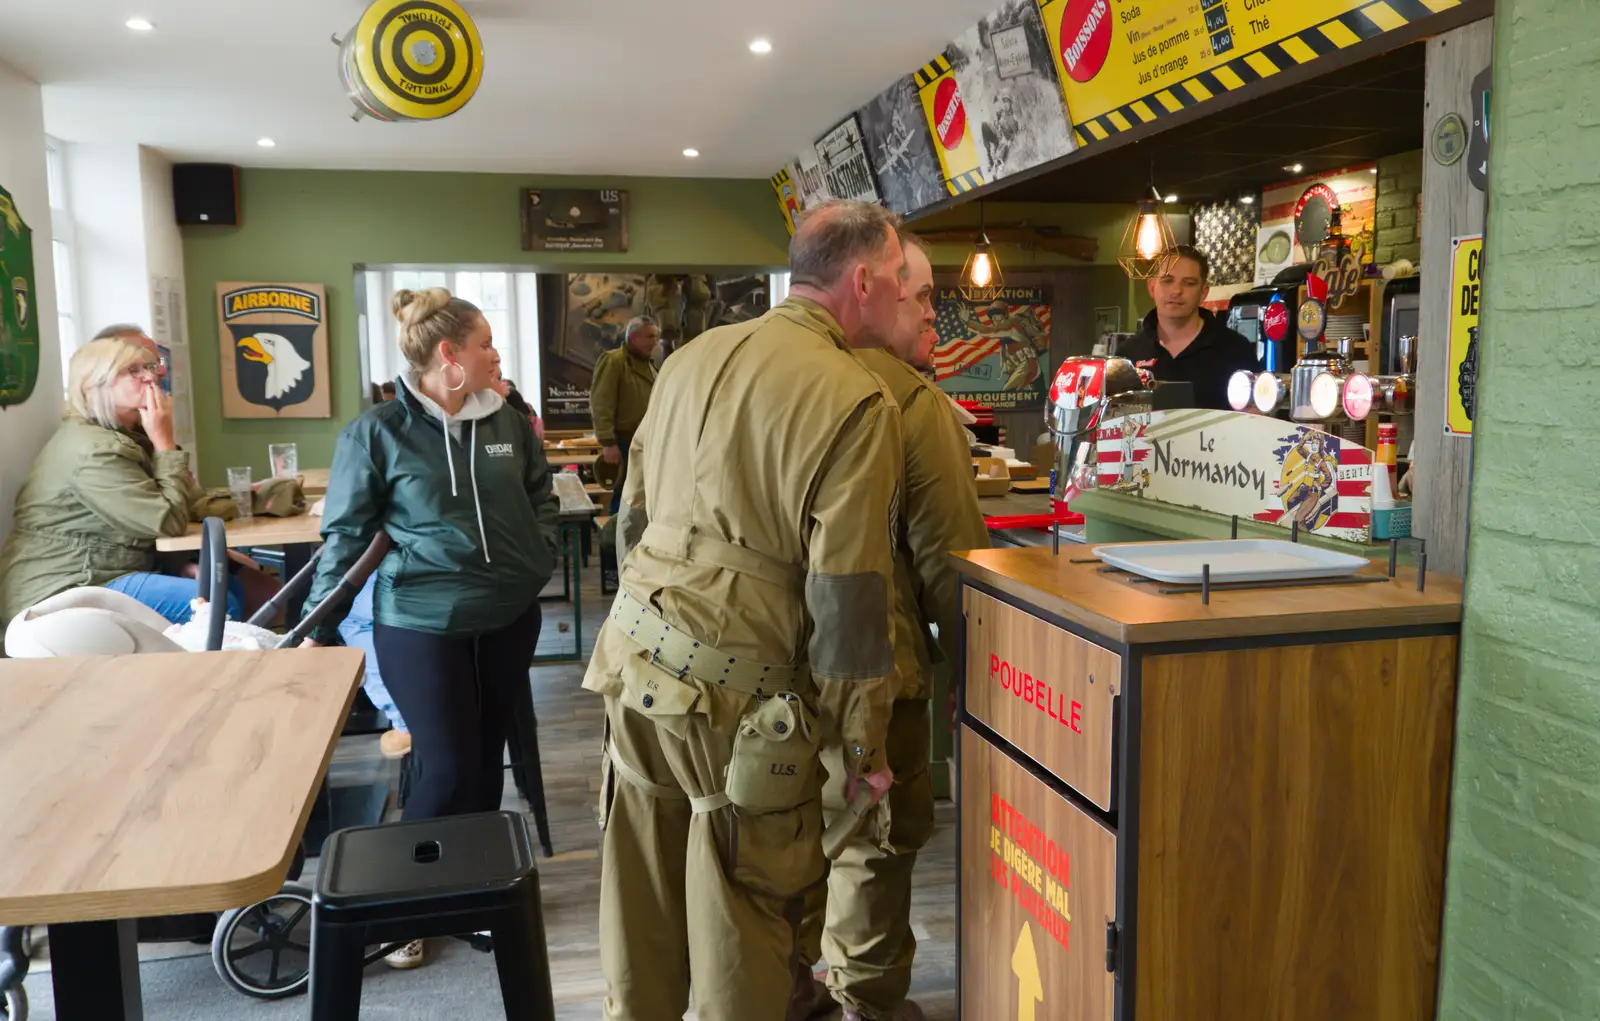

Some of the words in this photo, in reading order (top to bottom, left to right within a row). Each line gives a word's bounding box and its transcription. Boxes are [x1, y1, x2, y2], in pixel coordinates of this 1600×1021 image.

[398, 12, 453, 31] TRITONAL
[1120, 6, 1141, 24] Soda
[1249, 15, 1270, 35] Thé
[1063, 0, 1107, 71] BOISSONS
[1126, 30, 1140, 44] Vin
[1132, 51, 1146, 65] Jus
[1147, 45, 1158, 56] de
[1158, 28, 1190, 54] pomme
[1138, 71, 1152, 85] Jus
[1152, 54, 1189, 79] d'orange
[1212, 34, 1229, 52] 4,00
[1231, 26, 1236, 36] €
[398, 78, 453, 95] TRITONAL
[232, 291, 313, 313] AIRBORNE
[941, 290, 957, 299] LA
[1461, 284, 1479, 316] DE
[951, 391, 1040, 402] ÉBARQUEMENT
[1200, 431, 1215, 453] Le
[1152, 438, 1265, 500] Normandy
[990, 653, 1082, 735] POUBELLE
[770, 763, 798, 776] U.S.
[991, 792, 1070, 889] ATTENTION
[990, 825, 1001, 856] JE
[1003, 836, 1043, 895] DIGÈRE
[1045, 874, 1071, 922] MAL
[990, 852, 1008, 889] LES
[1012, 871, 1070, 953] PLATEAUX
